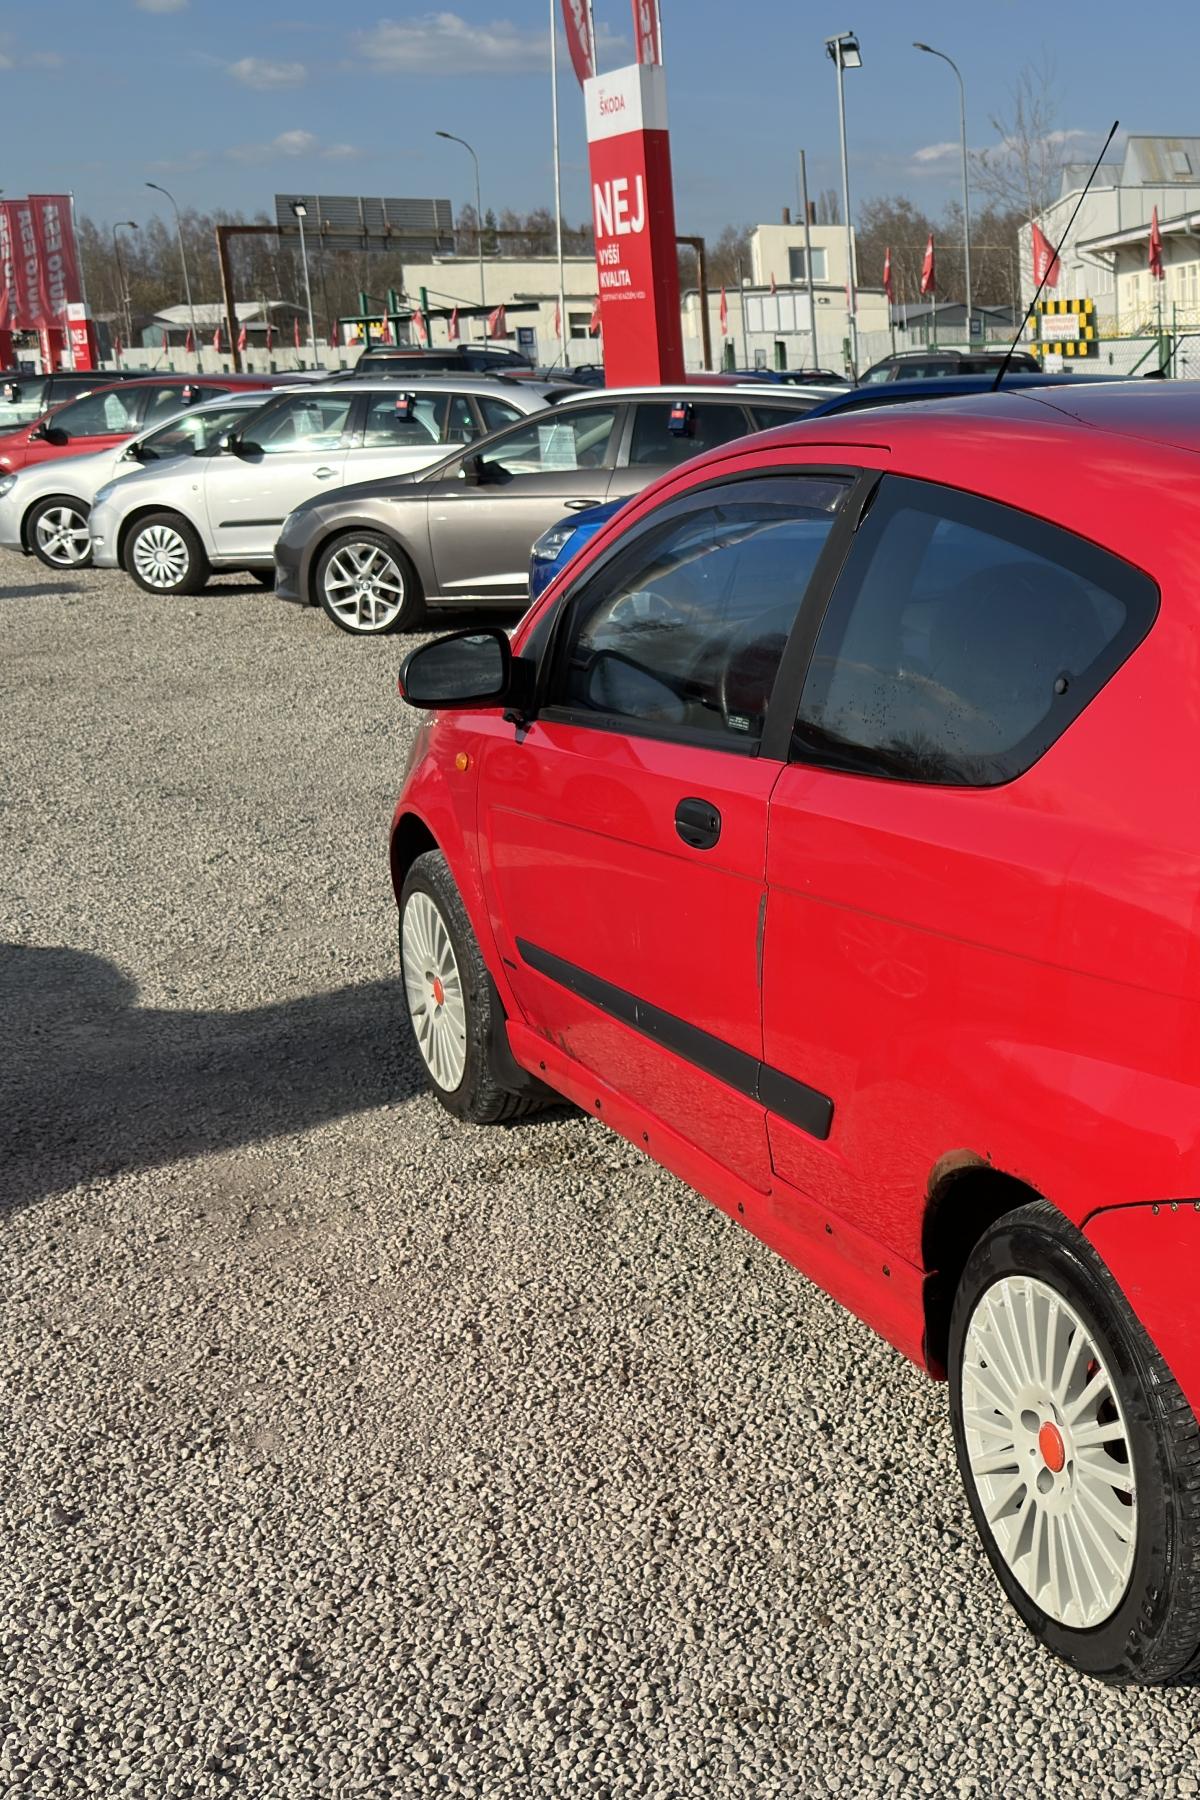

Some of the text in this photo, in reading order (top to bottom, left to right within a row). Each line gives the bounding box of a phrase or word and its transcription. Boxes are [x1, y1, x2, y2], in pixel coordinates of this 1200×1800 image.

[599, 94, 626, 116] ŠKODA
[594, 174, 645, 238] NEJ
[599, 243, 620, 266] VYŠŠÍ
[600, 269, 632, 288] KVALITA
